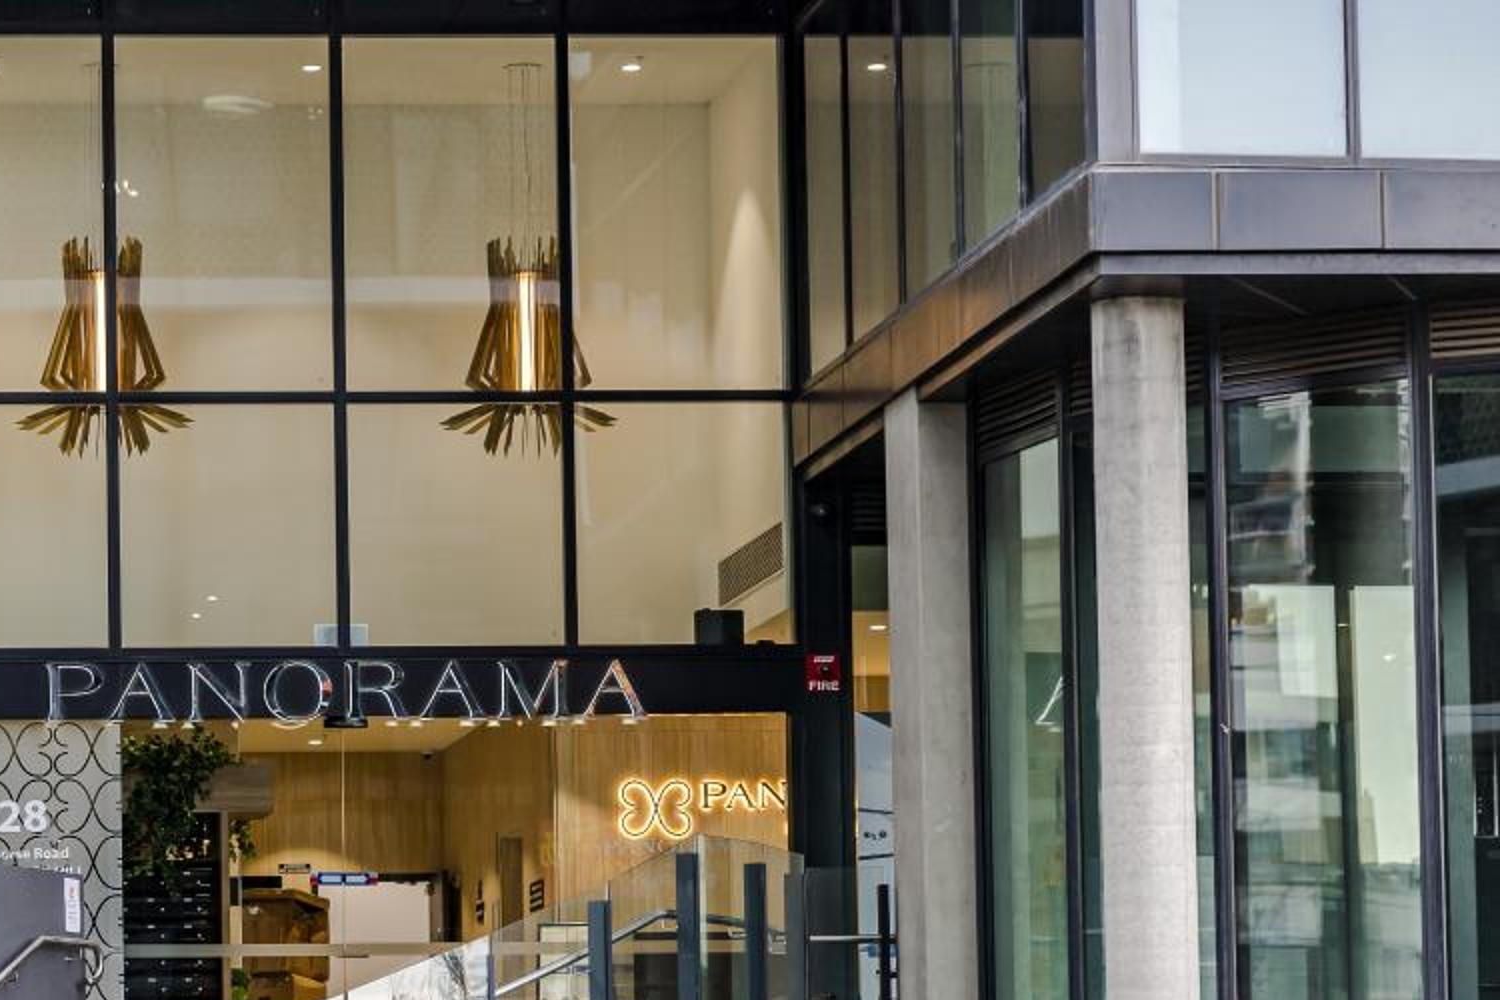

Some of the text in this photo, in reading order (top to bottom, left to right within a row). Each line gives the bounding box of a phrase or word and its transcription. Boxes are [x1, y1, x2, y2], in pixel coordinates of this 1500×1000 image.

[807, 681, 841, 692] FIRE
[45, 660, 649, 727] PANORAMA
[33, 847, 70, 860] Road
